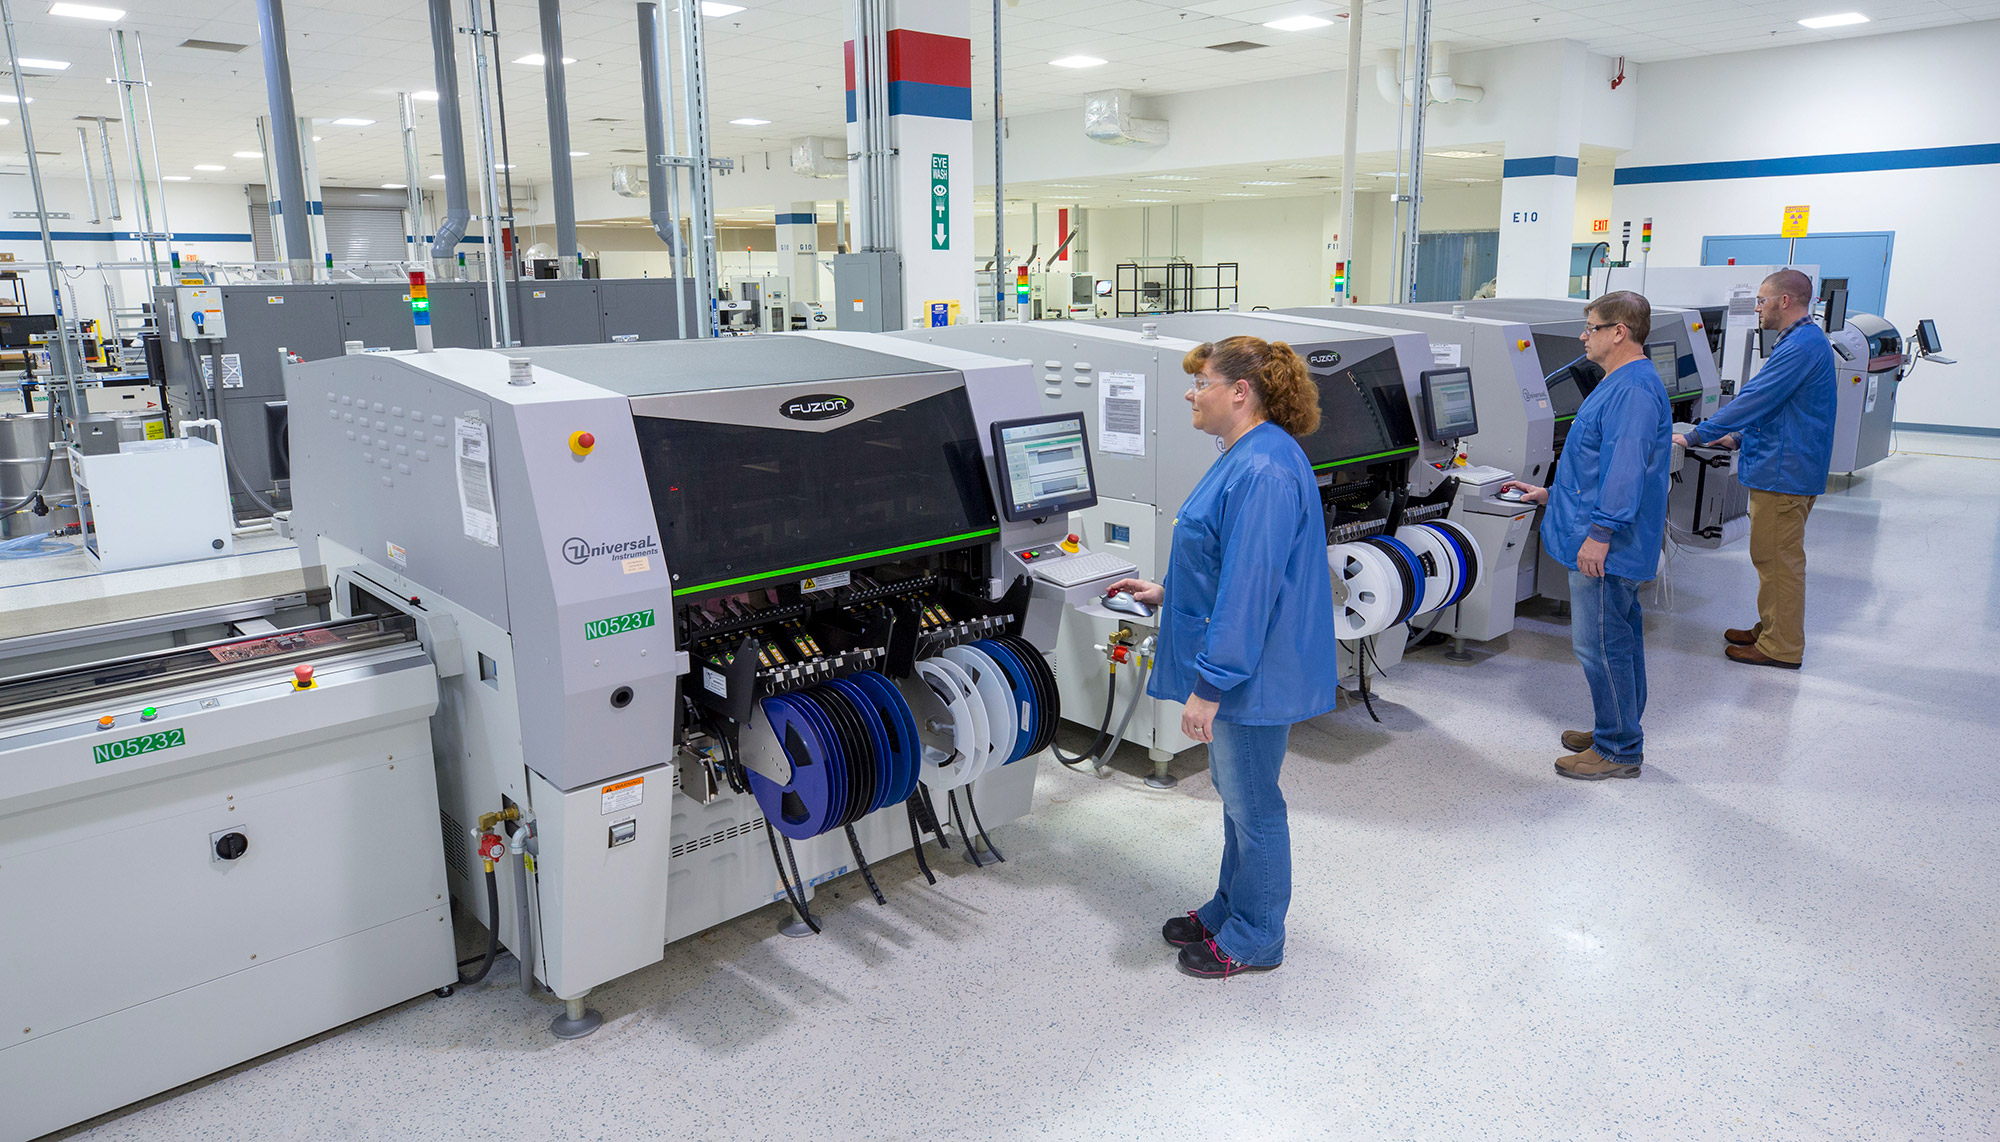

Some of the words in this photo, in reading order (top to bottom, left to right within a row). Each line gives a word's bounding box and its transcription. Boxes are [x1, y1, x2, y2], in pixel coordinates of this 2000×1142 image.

[933, 157, 947, 168] EYE
[933, 169, 947, 180] WASH
[1513, 212, 1538, 222] E10
[1594, 220, 1608, 231] EXIT
[186, 254, 197, 262] EXIT
[612, 549, 658, 561] Instruments
[615, 780, 641, 789] WARNING
